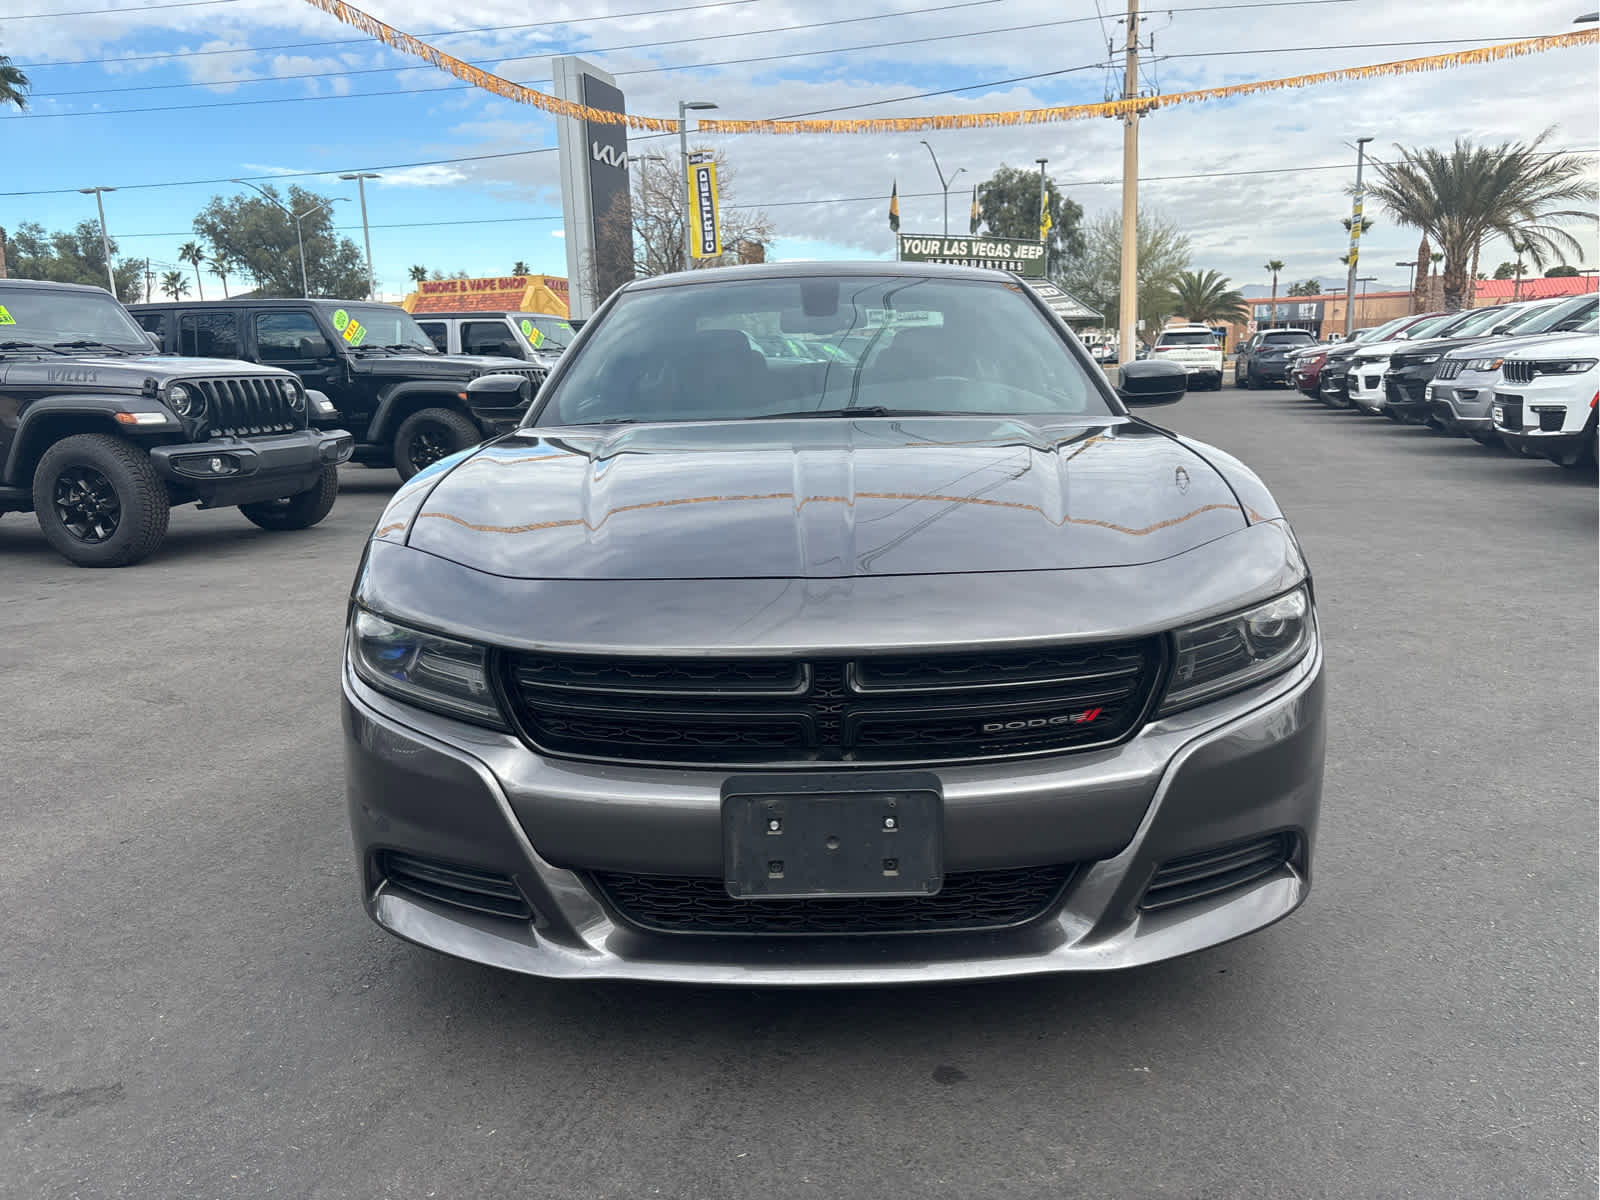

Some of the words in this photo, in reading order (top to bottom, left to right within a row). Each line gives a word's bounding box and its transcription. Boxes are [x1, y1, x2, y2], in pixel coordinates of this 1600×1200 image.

[700, 170, 715, 252] CERTIFIED
[903, 239, 940, 254] YOUR
[943, 241, 968, 255] LAS
[972, 242, 1011, 257] VEGAS
[1013, 245, 1043, 259] JEEP
[422, 281, 457, 294] SMOKE
[460, 281, 467, 292] &
[470, 279, 496, 291] VAPE
[499, 278, 526, 290] SHOP
[983, 712, 1088, 731] DODGE
